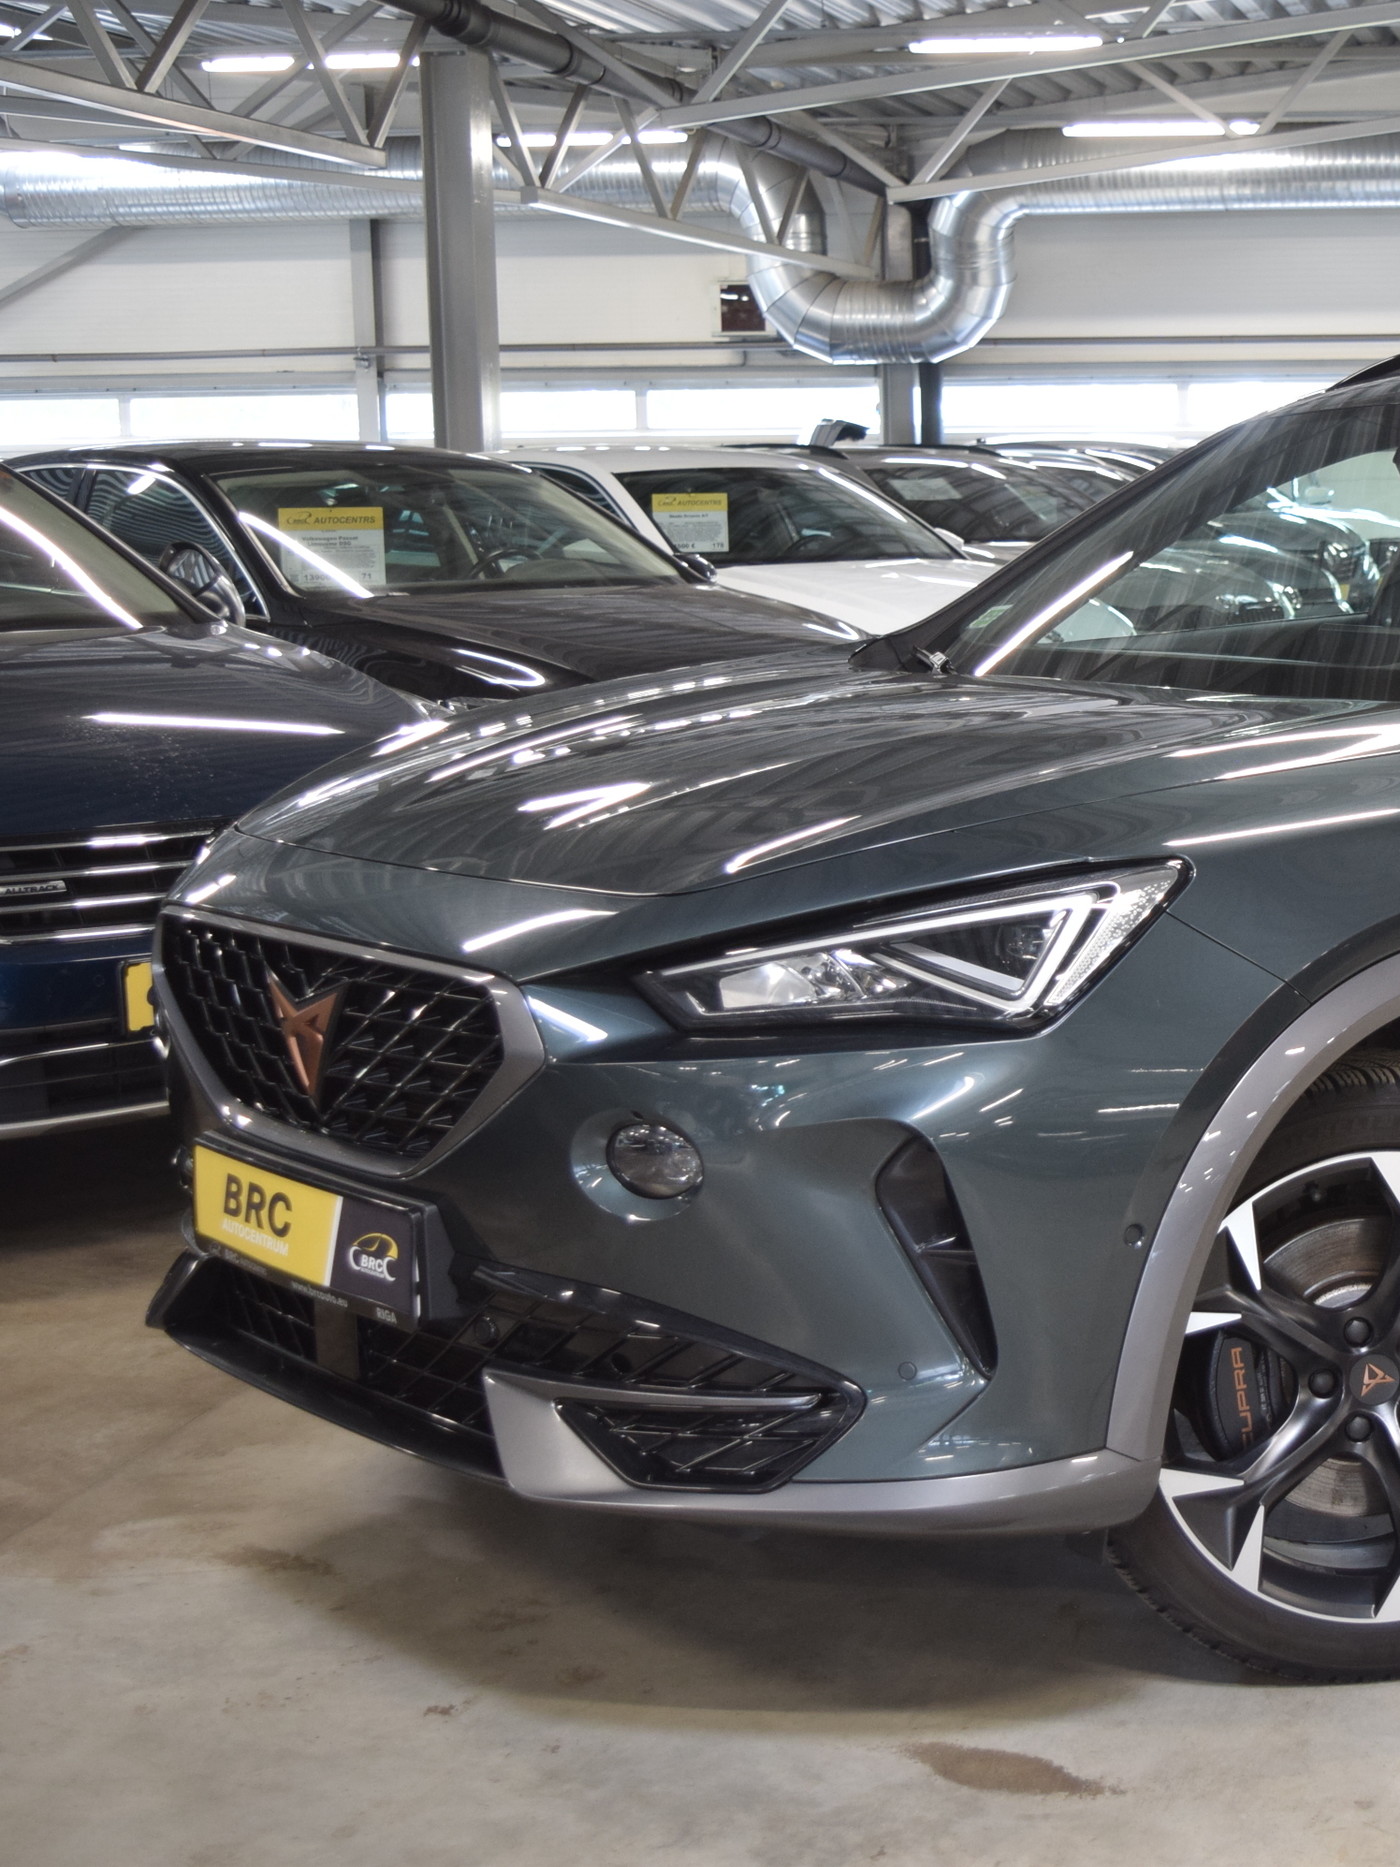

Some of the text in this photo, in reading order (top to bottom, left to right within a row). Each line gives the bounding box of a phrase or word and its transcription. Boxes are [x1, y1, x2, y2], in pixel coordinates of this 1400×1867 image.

[314, 515, 376, 525] AUTOCENTRS
[5, 884, 59, 895] ALLTRACK
[223, 1172, 293, 1239] BRC
[221, 1217, 289, 1257] AUTOCENTRUM
[376, 1306, 398, 1325] RIGA
